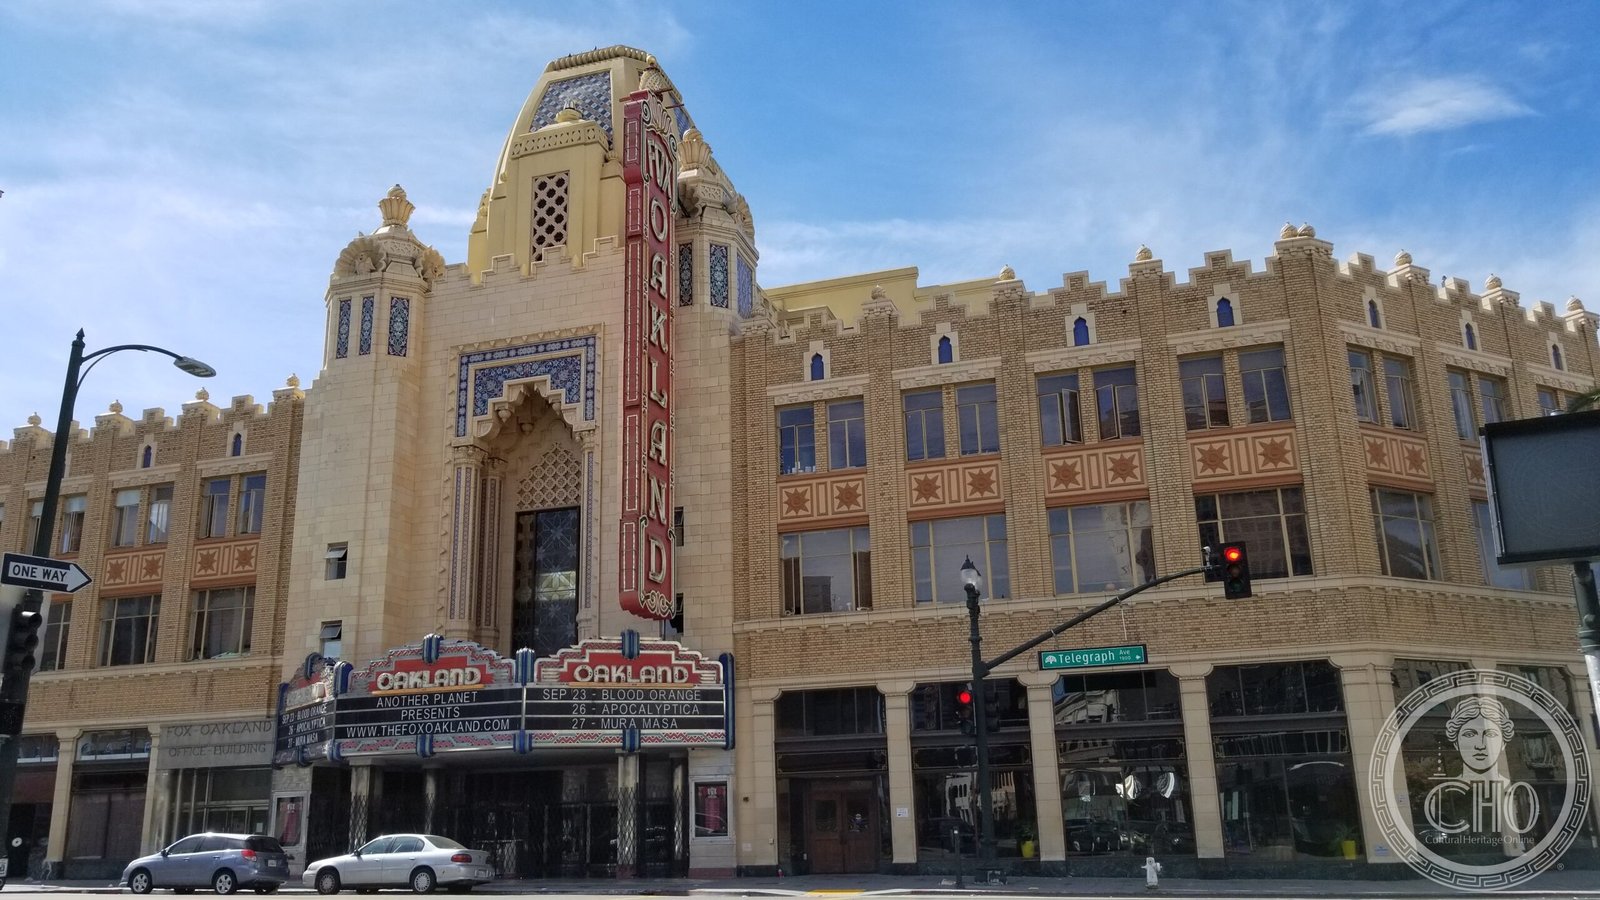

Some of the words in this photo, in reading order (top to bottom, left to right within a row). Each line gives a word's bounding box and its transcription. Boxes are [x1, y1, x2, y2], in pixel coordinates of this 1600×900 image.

[648, 196, 668, 585] OAKLAND
[12, 565, 37, 578] ONE
[42, 568, 67, 582] WAY
[1058, 650, 1115, 665] Telegraph
[376, 667, 482, 691] OAKLAND
[574, 664, 689, 683] OAKLAND
[376, 694, 429, 708] ANOTHER
[434, 691, 478, 705] PLANET
[543, 688, 567, 700] SEP
[572, 688, 587, 700] 23
[601, 689, 644, 700] BLOOD
[649, 689, 701, 701] ORANGE
[401, 706, 461, 720] PRESENTS
[572, 703, 586, 715] 26
[601, 703, 700, 715] APOCALYPTICA
[166, 724, 192, 738] FOX
[200, 720, 272, 736] OAKLAND
[346, 718, 510, 738] WWW.THEFOXOAKLAND.COM
[571, 718, 586, 729] 27
[601, 718, 636, 729] MURA
[642, 718, 678, 729] MASA
[168, 746, 206, 758] OFFICE
[213, 743, 266, 756] BUILDING
